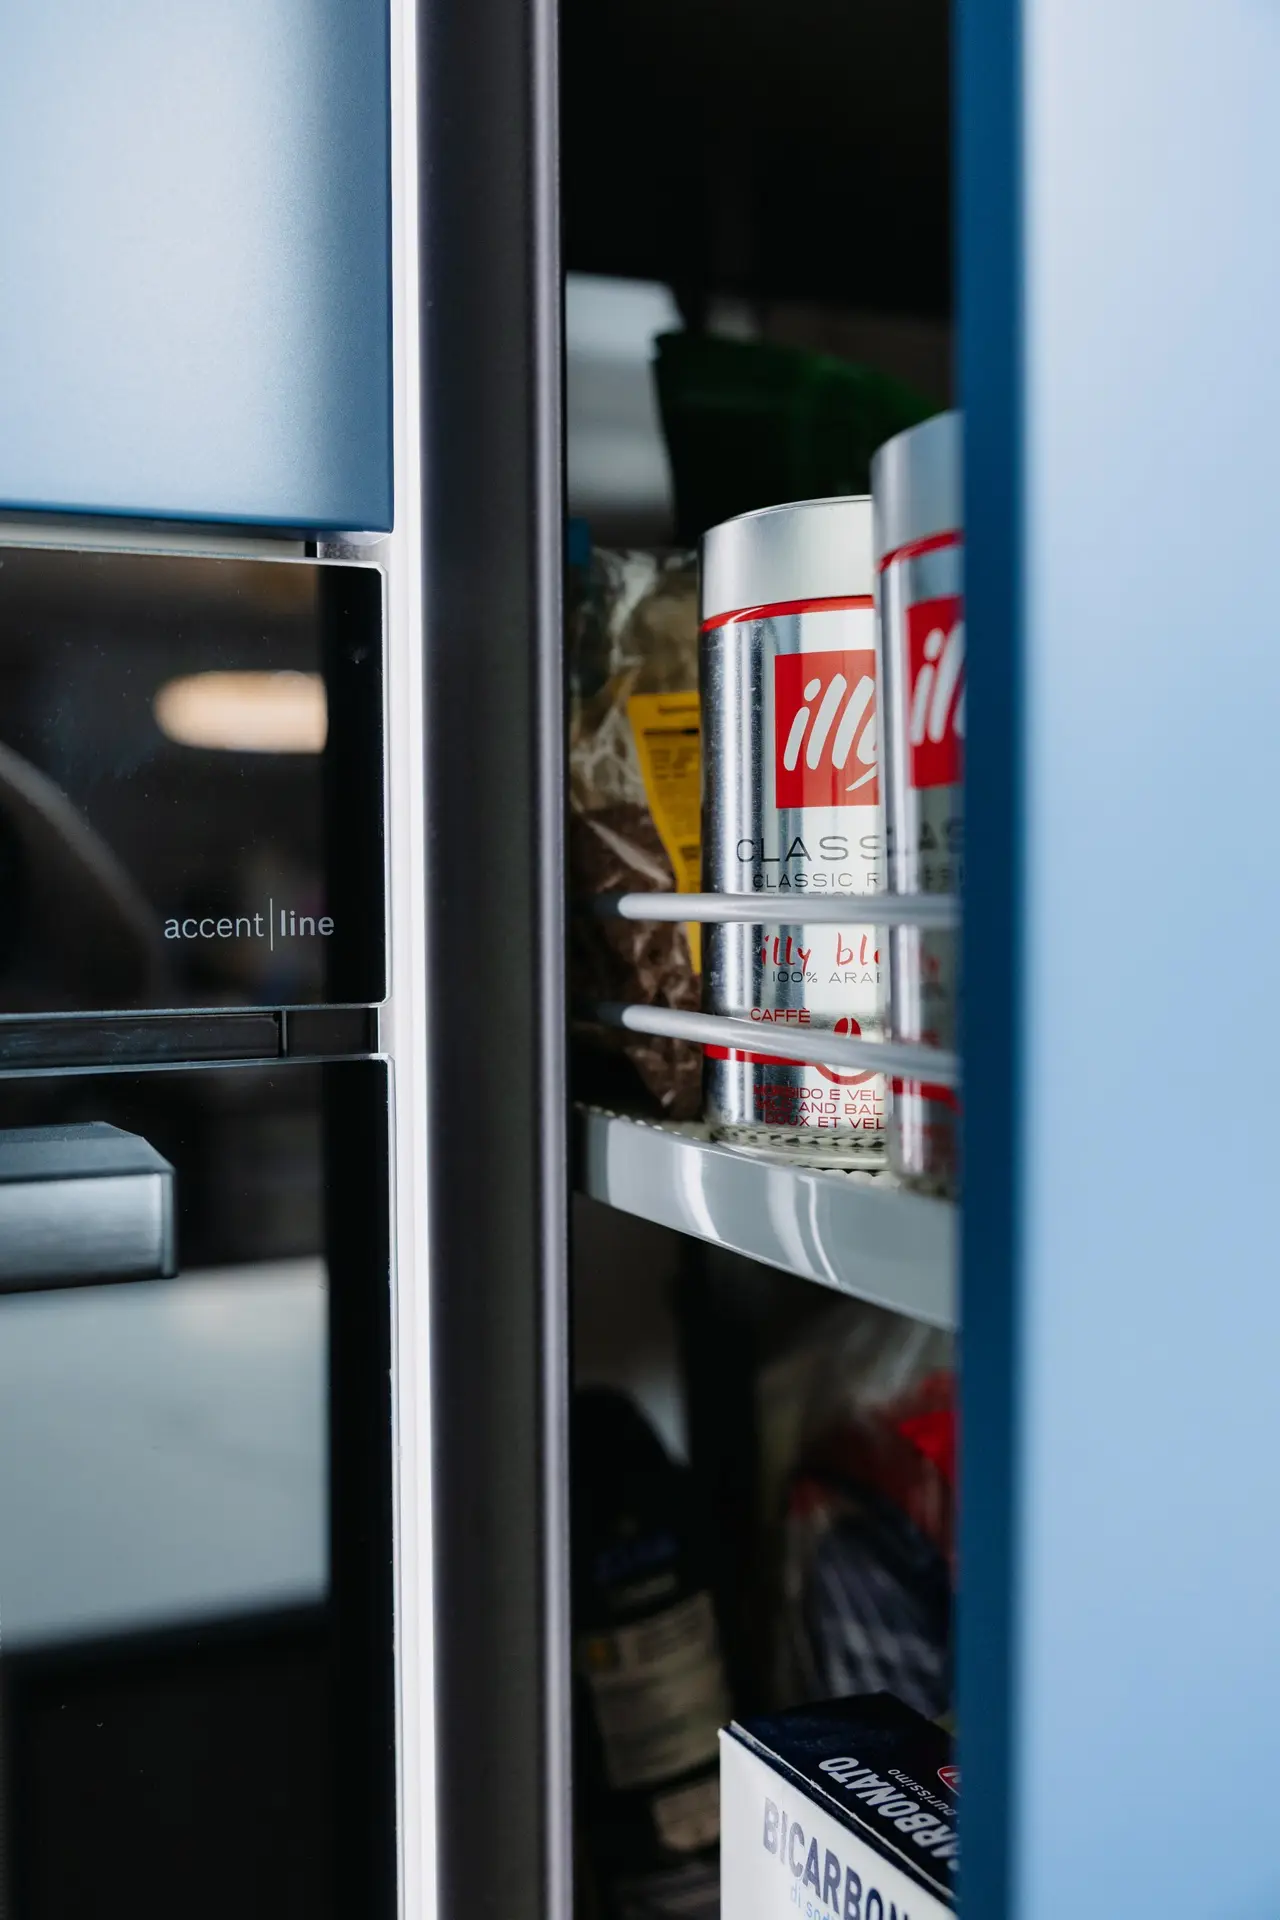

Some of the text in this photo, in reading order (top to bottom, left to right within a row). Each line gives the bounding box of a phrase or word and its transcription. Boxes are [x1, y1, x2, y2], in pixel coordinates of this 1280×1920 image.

[753, 872, 853, 888] CLASSIC
[164, 909, 335, 939] accent line
[761, 934, 812, 974] illy
[772, 971, 819, 984] 100%
[750, 1007, 811, 1023] CAFFÈ
[829, 1088, 841, 1101] E
[799, 1102, 837, 1114] AND
[817, 1116, 841, 1128] ET
[818, 1756, 963, 1872] ARBONATO
[762, 1796, 910, 1920] BICARBO
